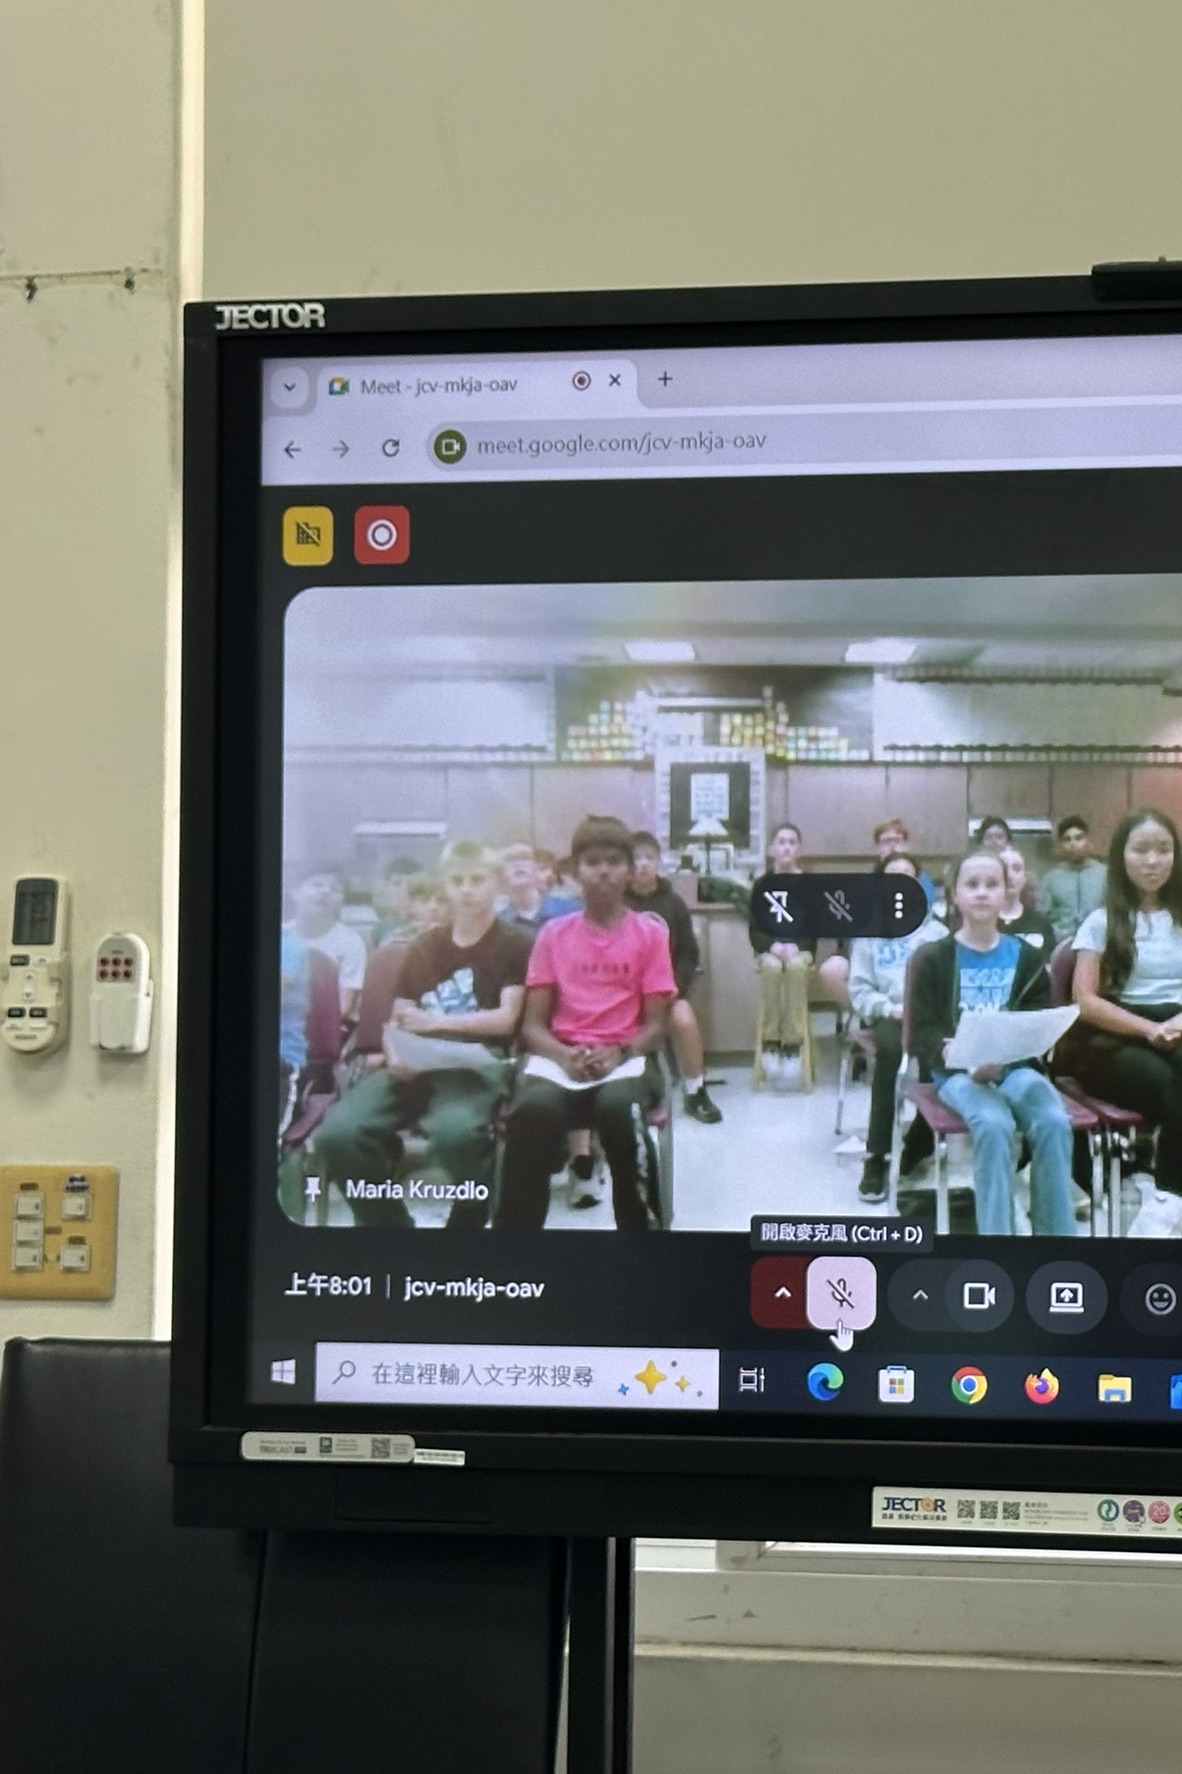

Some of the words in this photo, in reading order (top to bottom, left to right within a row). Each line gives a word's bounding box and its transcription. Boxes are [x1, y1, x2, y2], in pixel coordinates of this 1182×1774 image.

[214, 302, 325, 330] JECTOR
[361, 378, 402, 394] Meet
[415, 377, 518, 397] jcv-mkja-oav
[477, 431, 768, 457] meet.google.com/jcv-mkja-oav
[346, 1179, 404, 1199] Maria
[409, 1179, 489, 1200] Kruzdlo
[761, 1223, 848, 1241] 開啟麥克風
[851, 1224, 887, 1243] (Ctrl
[904, 1225, 923, 1244] D)
[284, 1273, 372, 1296] 上午8:01
[403, 1276, 545, 1302] jcv-mkja-oav
[372, 1362, 594, 1387] 在這裡輸入文字來搜尋
[882, 1497, 947, 1513] JECTOR
